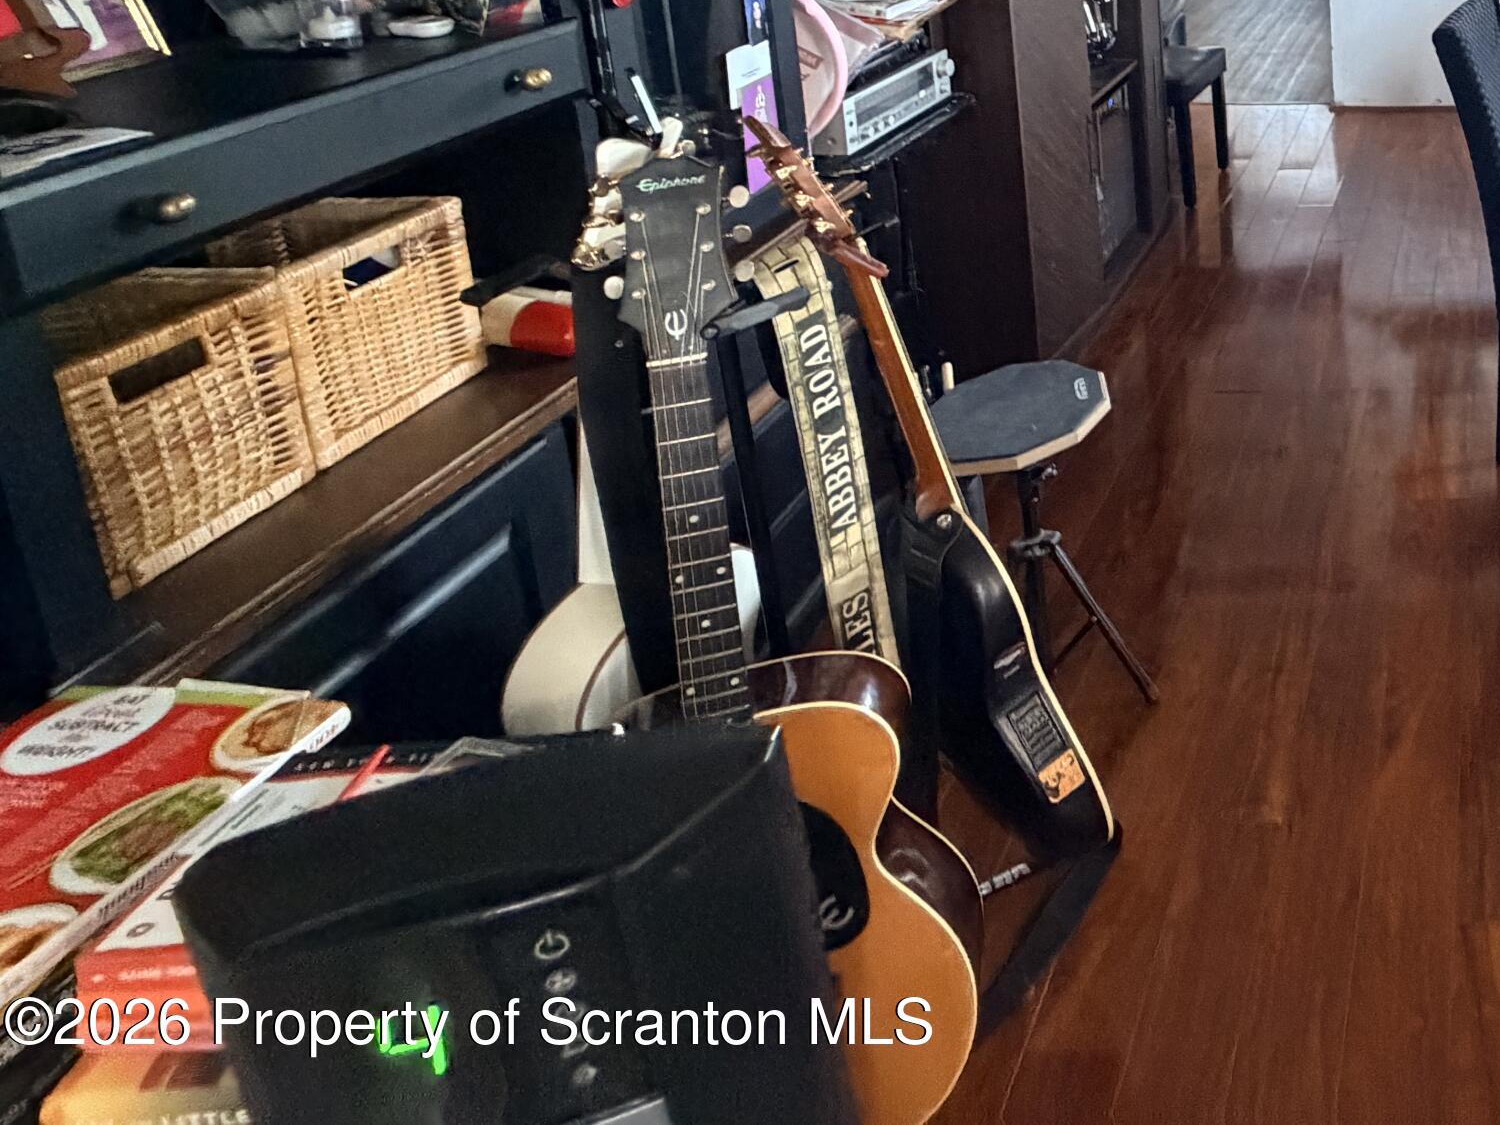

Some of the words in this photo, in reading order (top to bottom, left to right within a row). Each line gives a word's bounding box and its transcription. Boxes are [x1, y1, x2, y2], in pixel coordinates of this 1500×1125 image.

[637, 175, 706, 193] Epiphone
[801, 324, 842, 420] ROAD
[817, 425, 858, 532] ABBEY
[842, 590, 878, 654] LES
